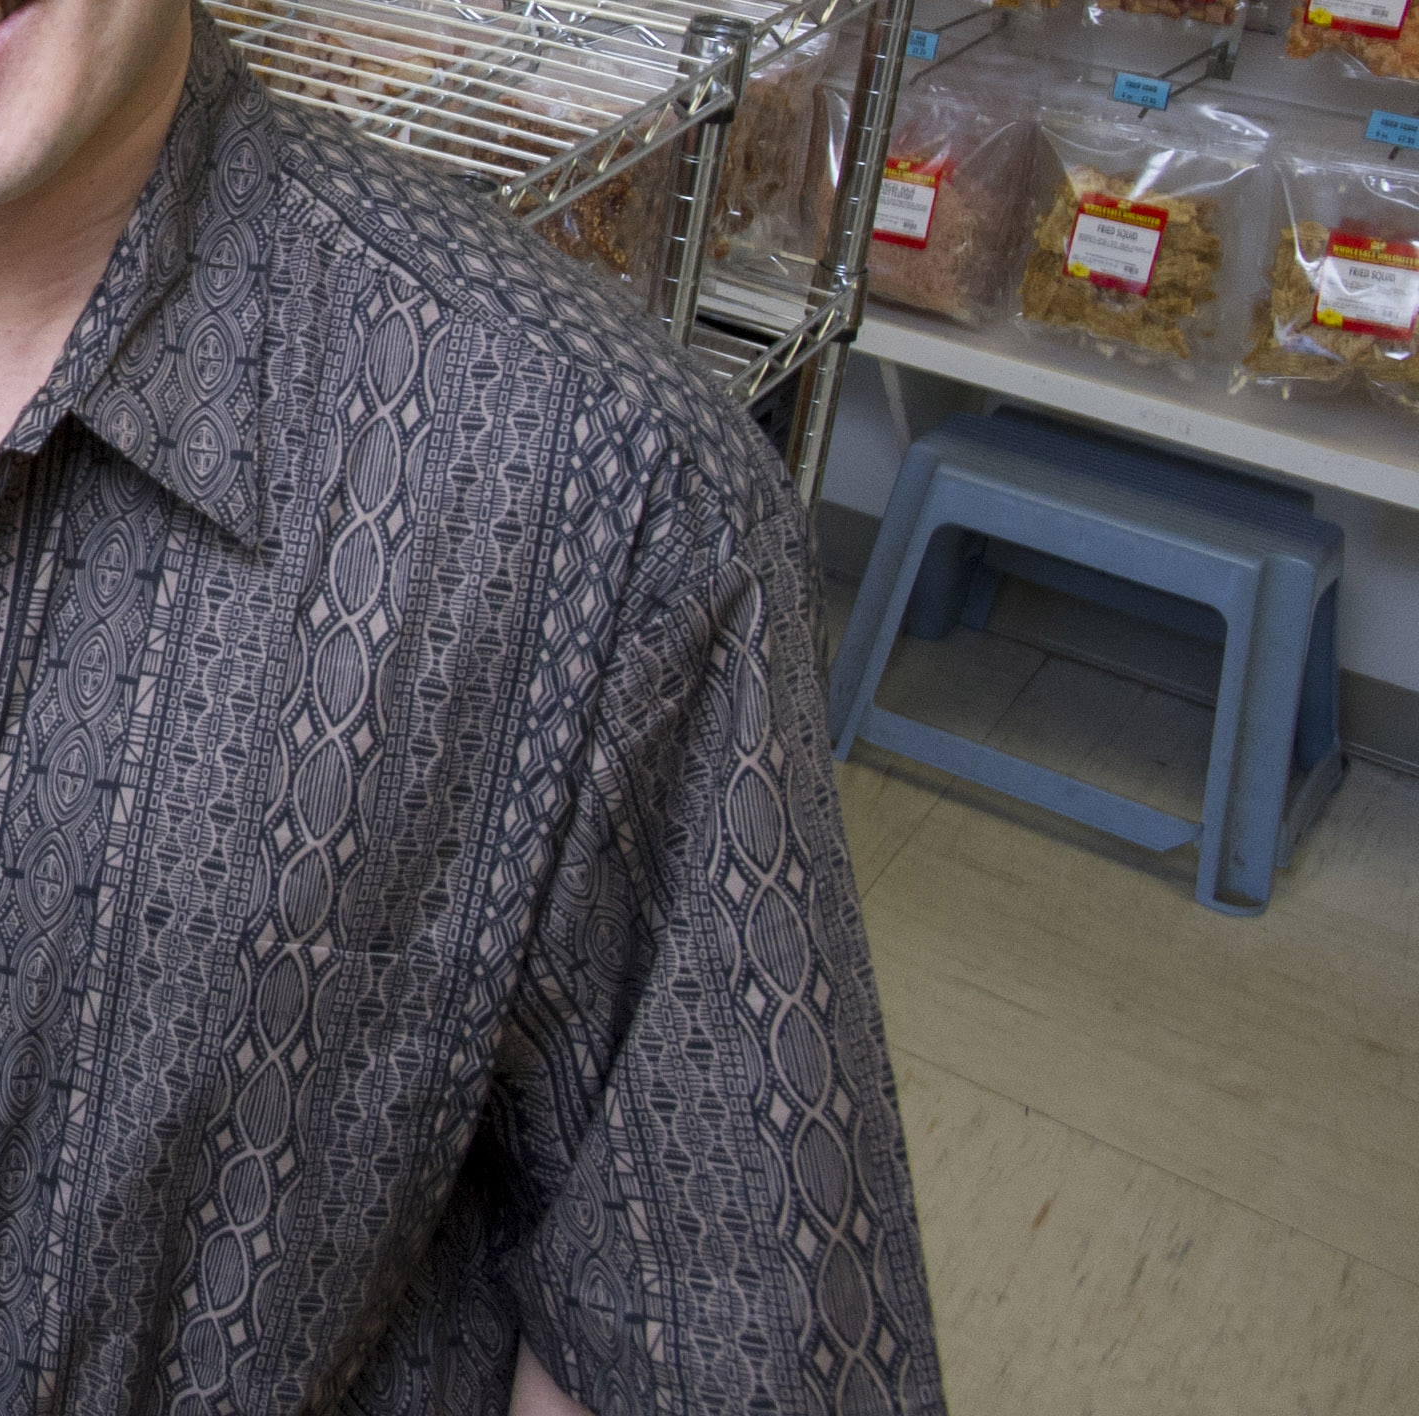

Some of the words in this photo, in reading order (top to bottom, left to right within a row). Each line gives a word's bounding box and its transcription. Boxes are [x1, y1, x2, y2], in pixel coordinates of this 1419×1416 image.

[1097, 223, 1115, 236] FRIED
[1116, 227, 1139, 241] SQUID
[1349, 266, 1369, 278] FRIED
[1370, 270, 1396, 282] SQUID
